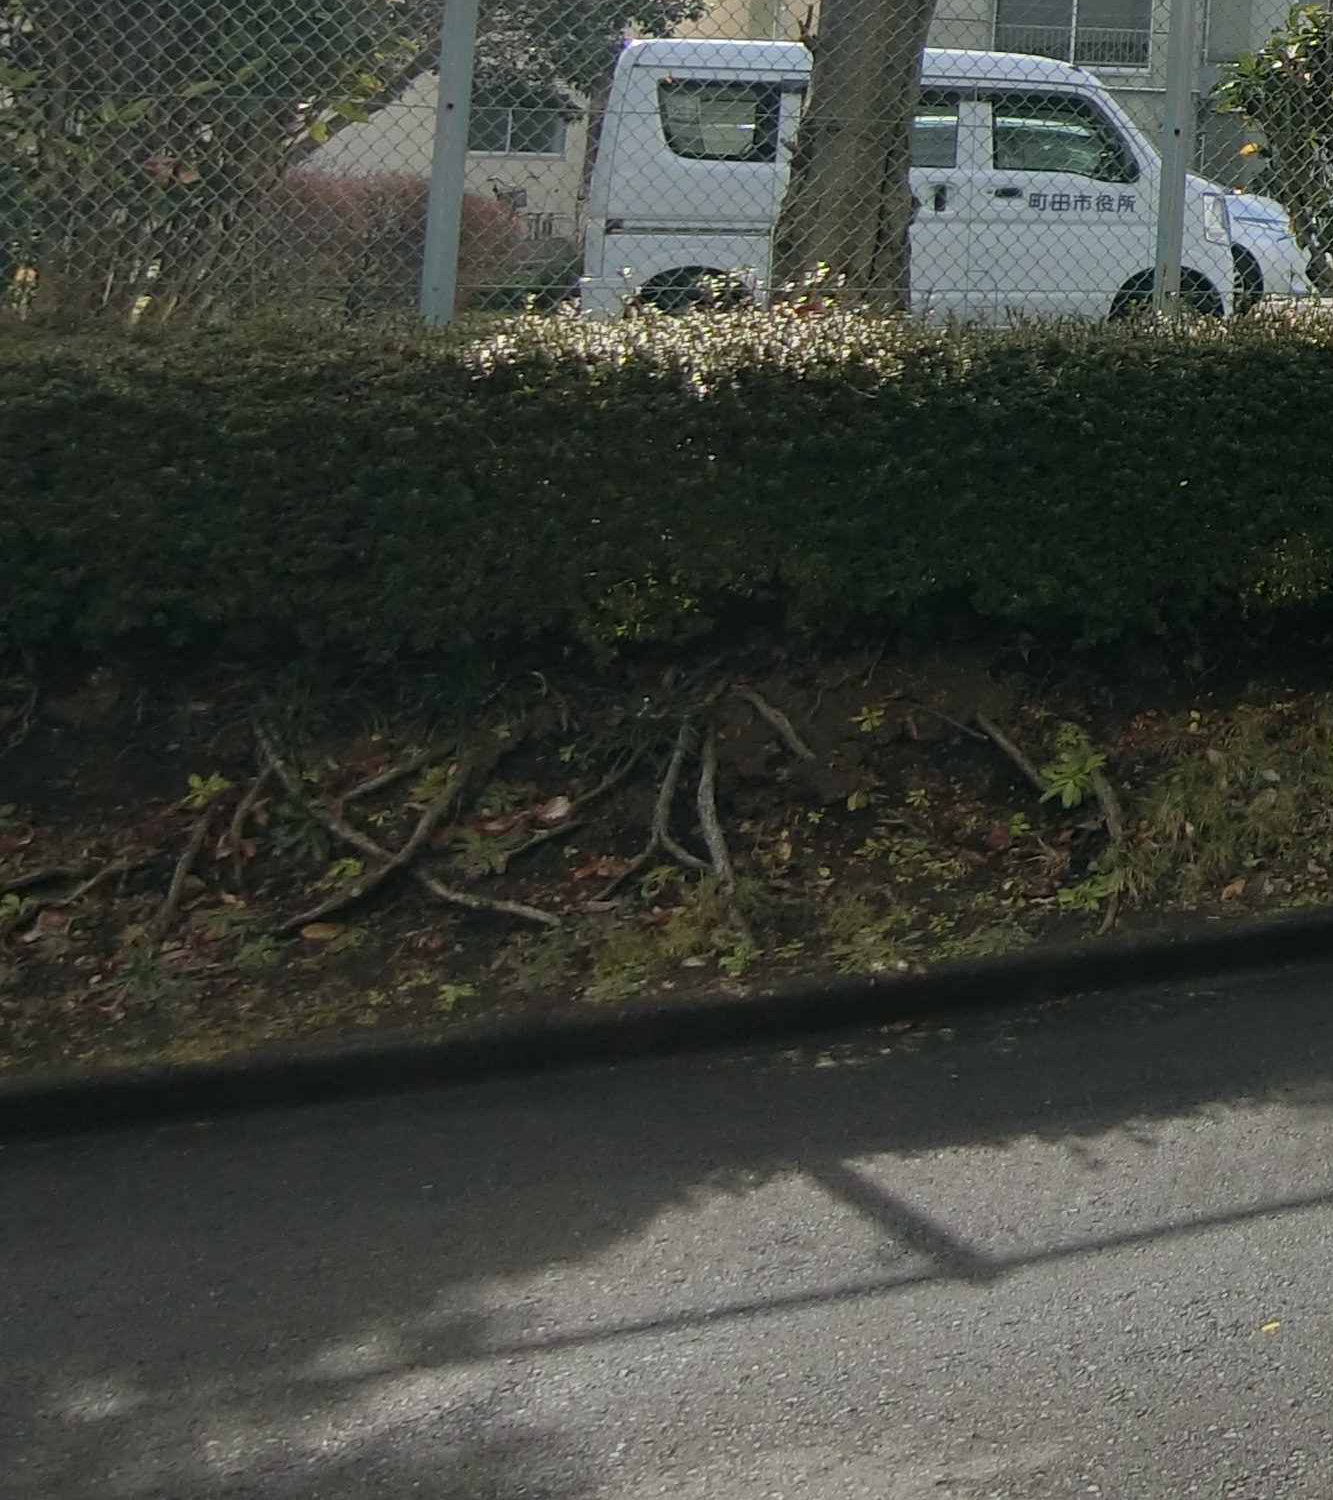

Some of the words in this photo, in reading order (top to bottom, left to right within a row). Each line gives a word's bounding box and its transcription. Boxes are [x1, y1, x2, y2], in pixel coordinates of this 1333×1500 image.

[1028, 192, 1137, 213] 町田市役所
